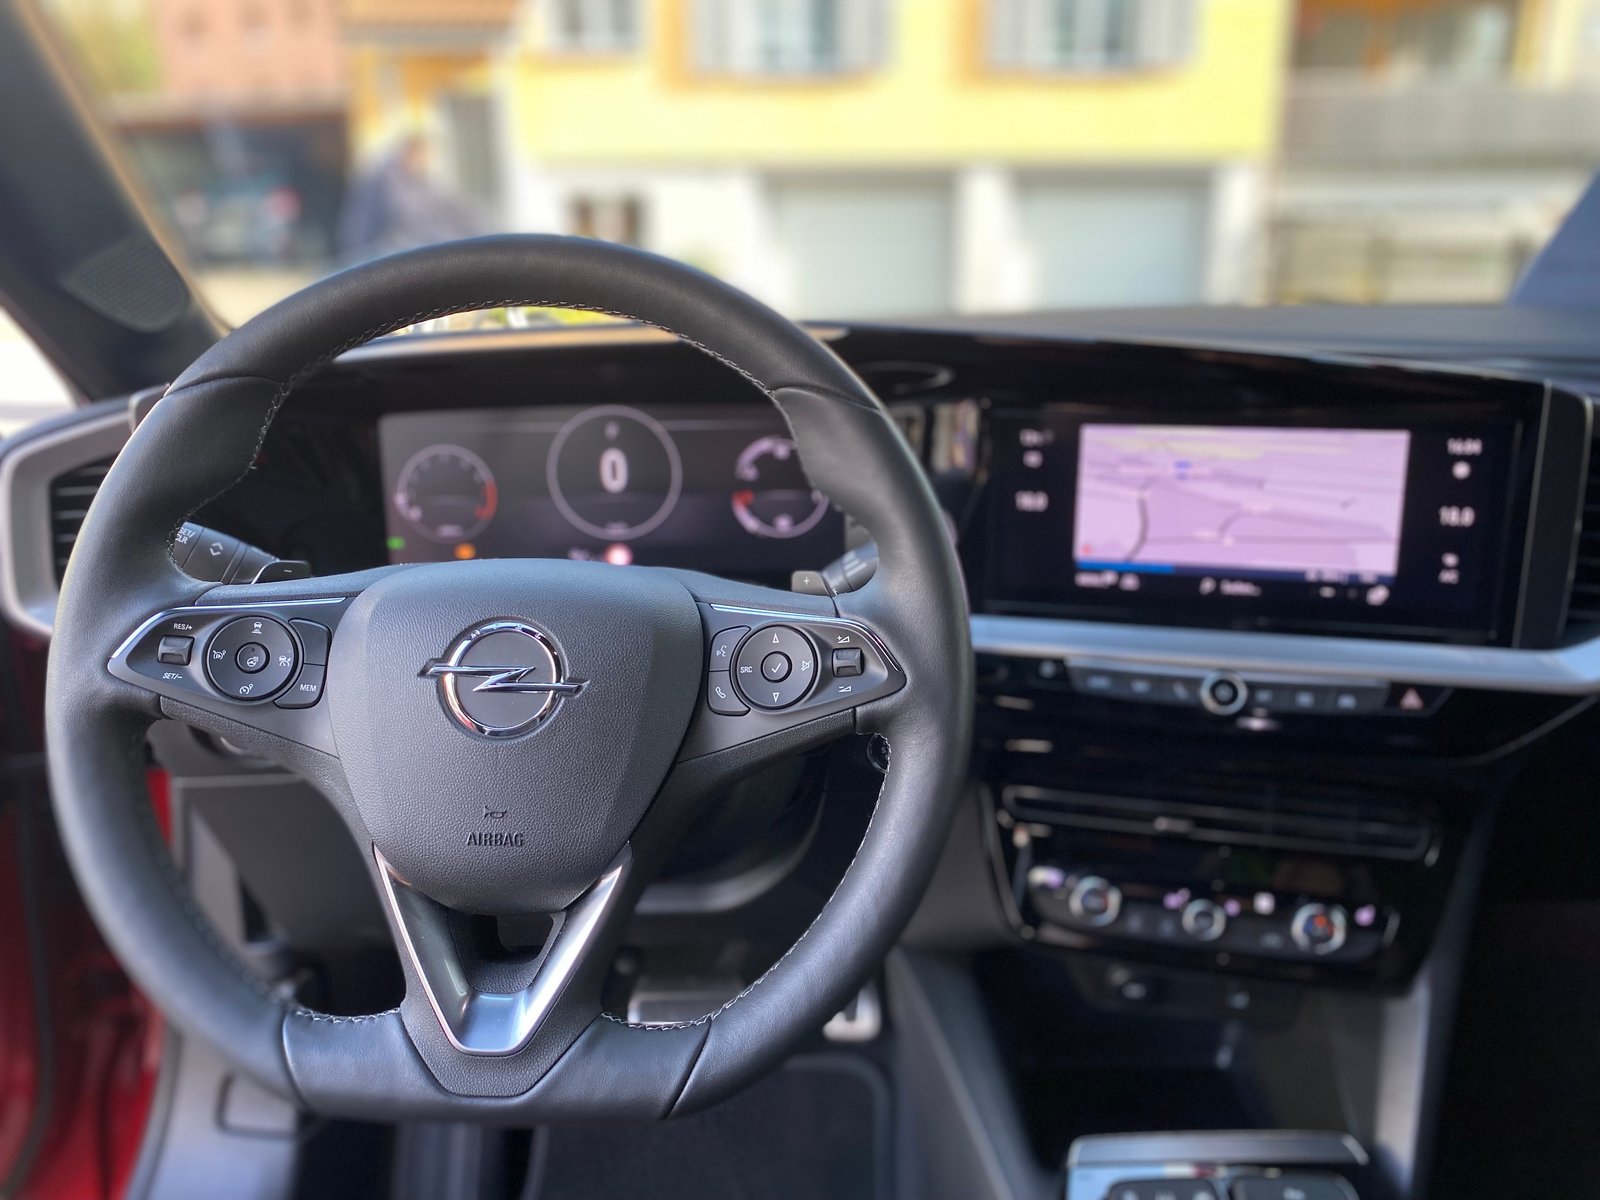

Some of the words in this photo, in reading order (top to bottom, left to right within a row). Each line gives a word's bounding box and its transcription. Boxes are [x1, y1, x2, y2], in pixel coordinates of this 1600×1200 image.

[600, 448, 628, 493] 0
[300, 684, 317, 692] MEM
[466, 832, 524, 847] AIRBAG
